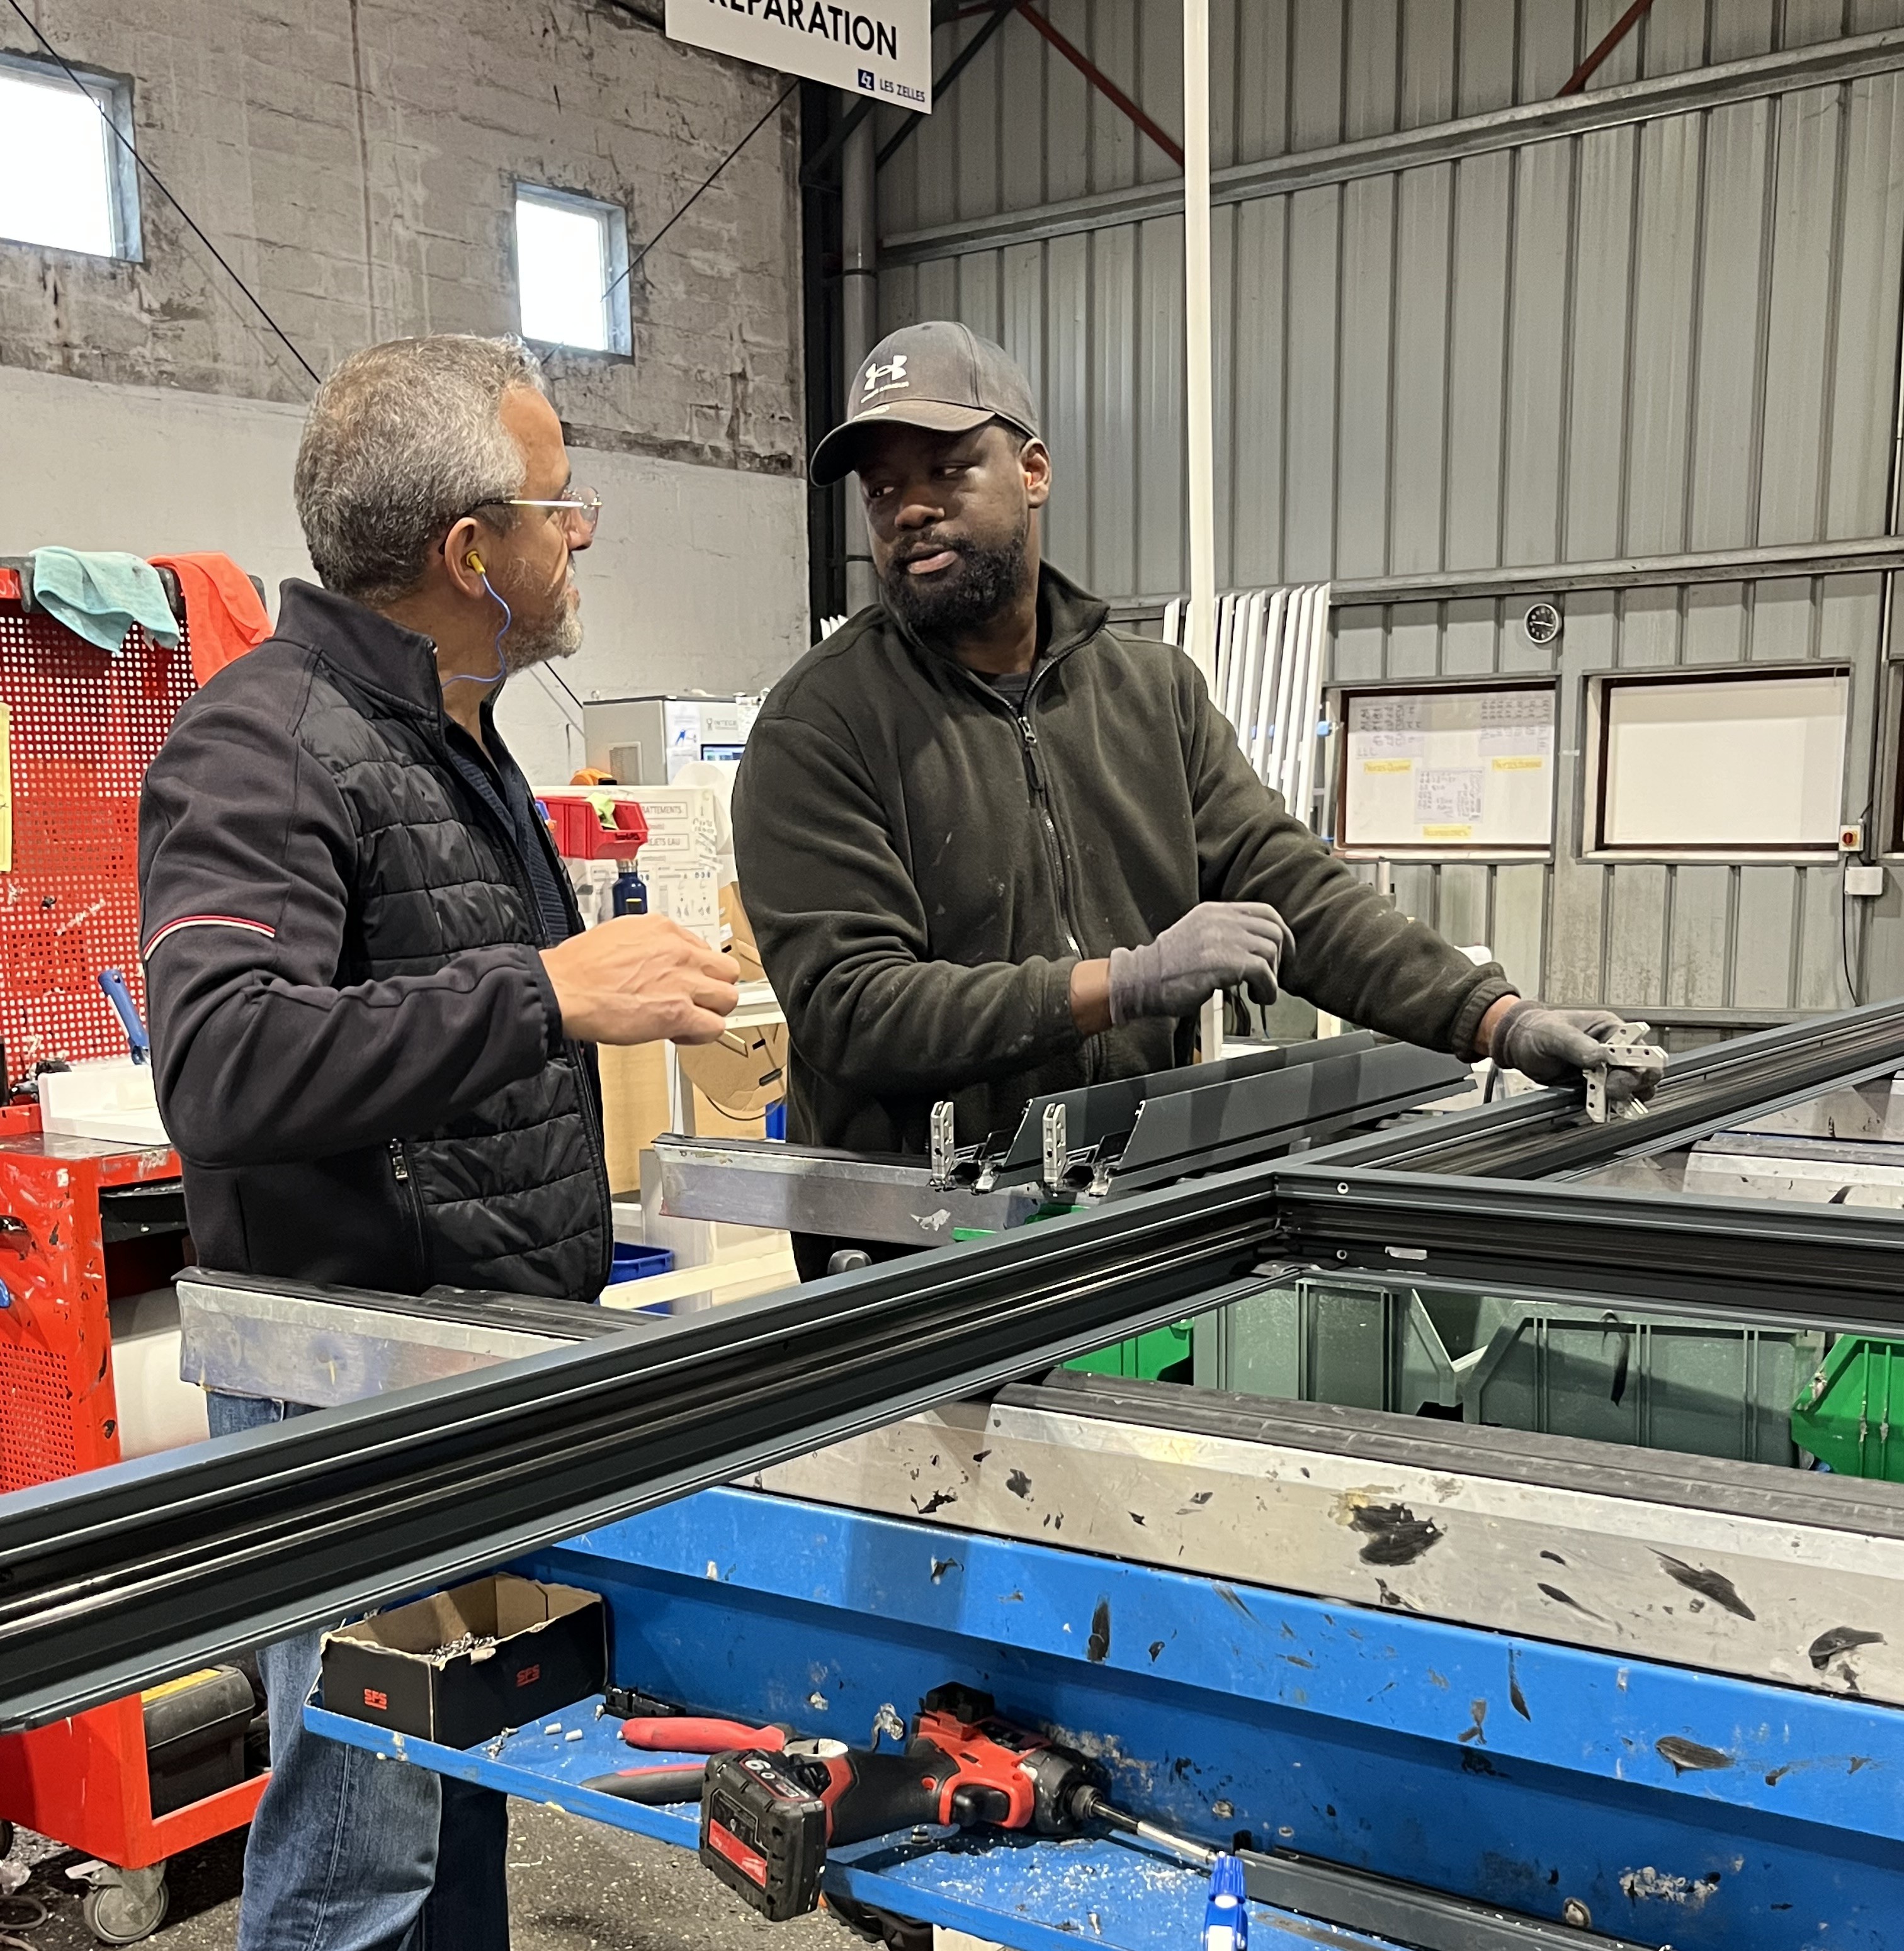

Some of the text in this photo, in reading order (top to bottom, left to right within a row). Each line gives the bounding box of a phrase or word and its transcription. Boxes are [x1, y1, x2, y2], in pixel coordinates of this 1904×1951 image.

[880, 78, 925, 103] LES ZELLES
[516, 1664, 540, 1683] SFS
[364, 1688, 388, 1706] SFS
